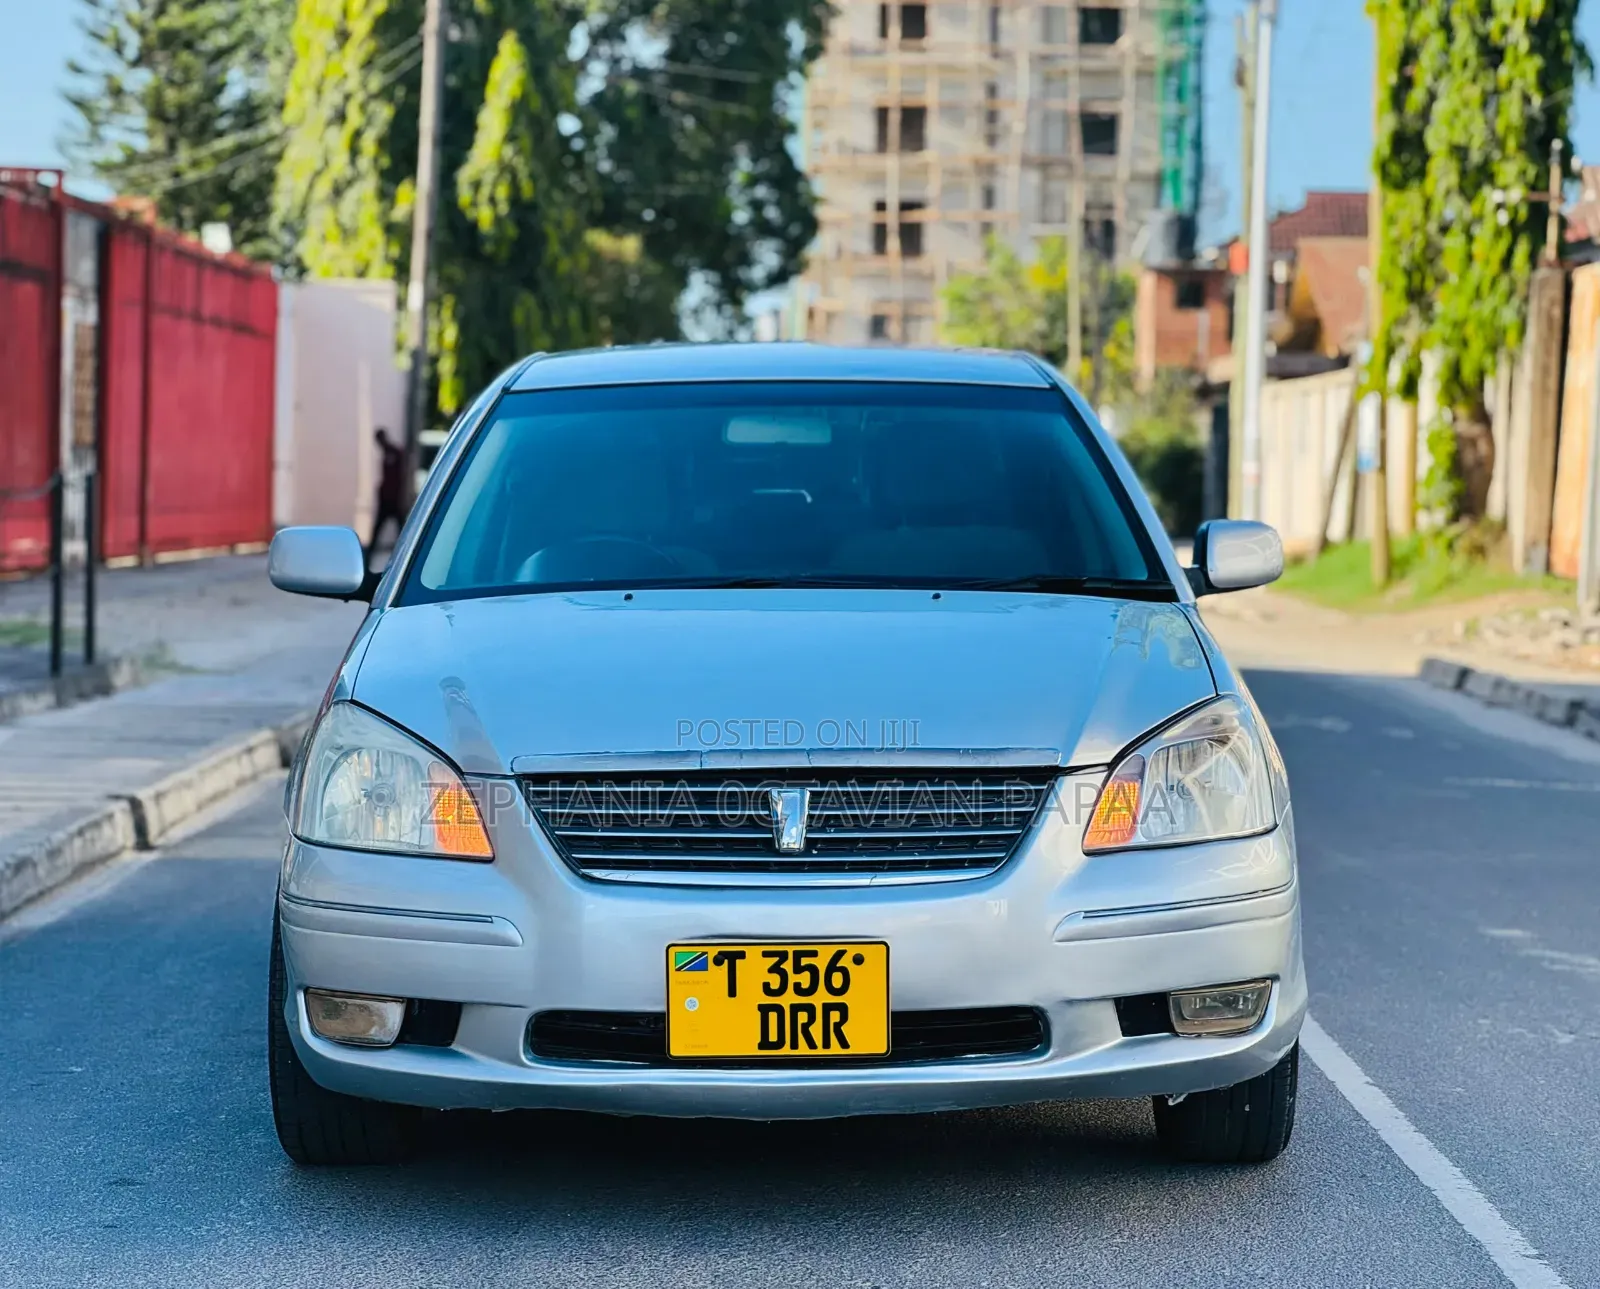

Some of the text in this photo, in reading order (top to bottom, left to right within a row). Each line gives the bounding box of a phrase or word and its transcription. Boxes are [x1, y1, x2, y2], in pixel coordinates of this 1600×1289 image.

[717, 949, 851, 998] T 356
[757, 1001, 851, 1051] DRR
